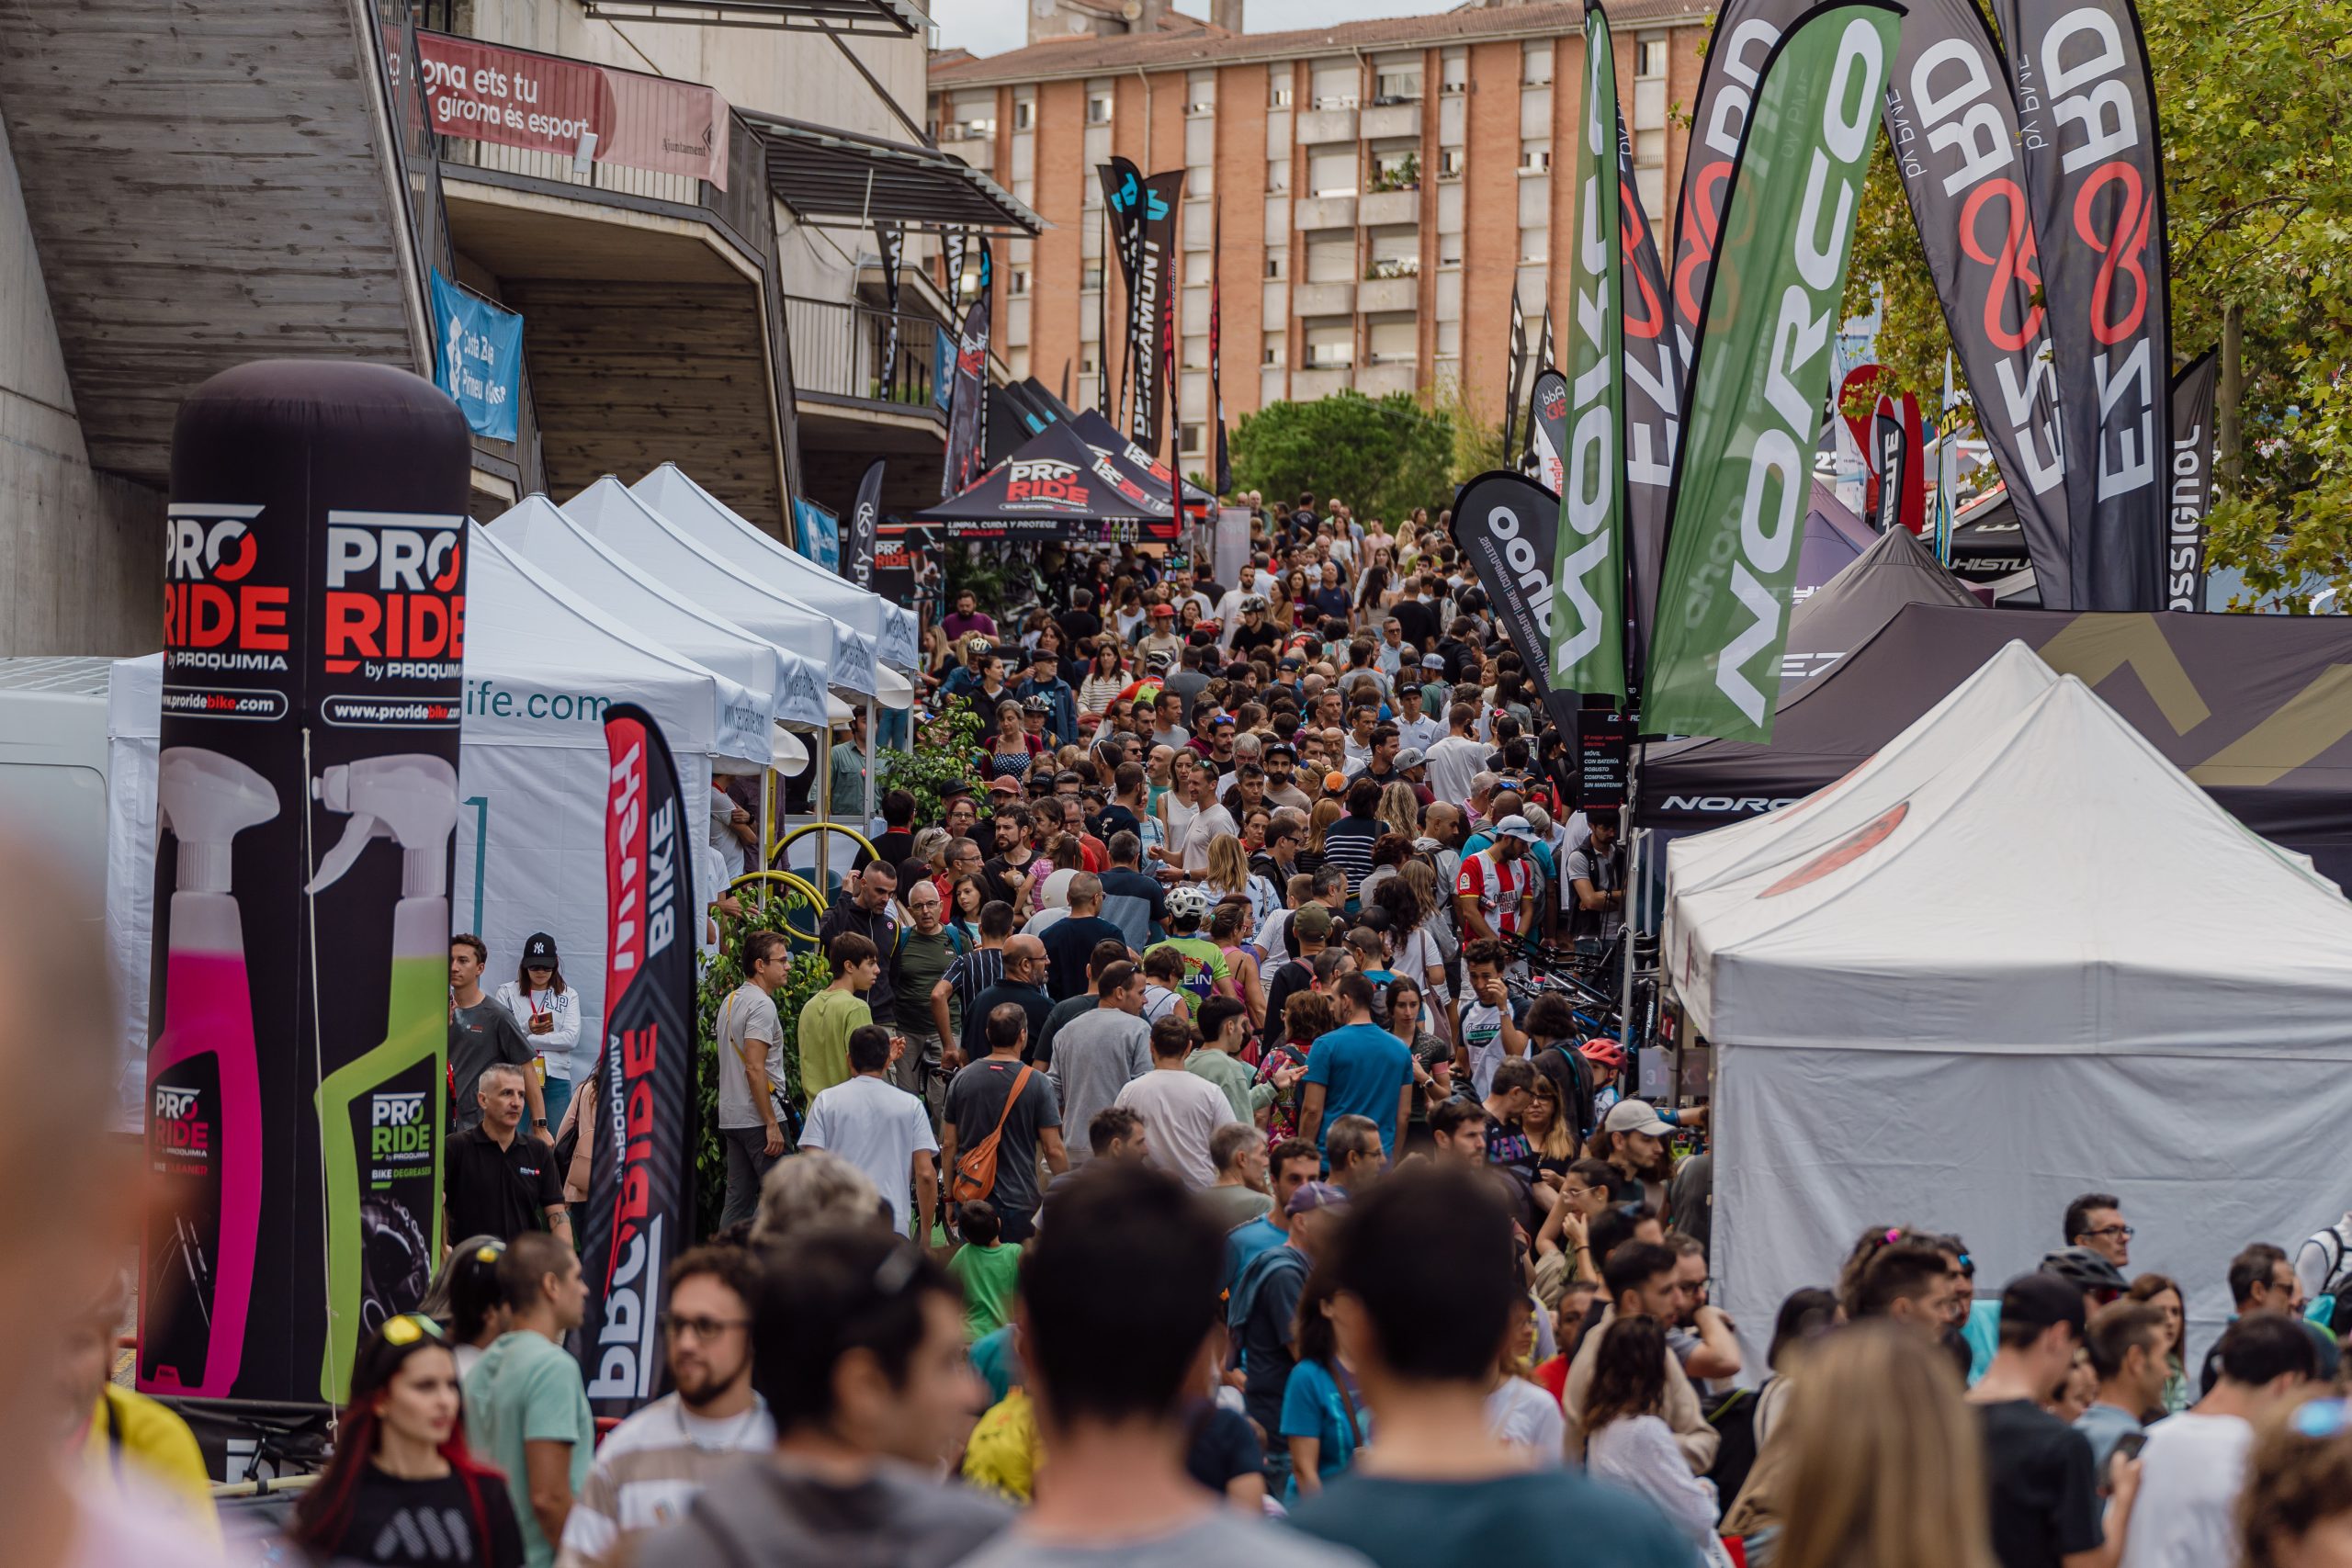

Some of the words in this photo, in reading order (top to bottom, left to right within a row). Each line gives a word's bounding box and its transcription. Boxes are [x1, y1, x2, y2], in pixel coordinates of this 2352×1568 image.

[473, 67, 508, 98] ets
[514, 73, 537, 104] tu
[437, 92, 501, 125] girona
[505, 103, 525, 130] és
[528, 111, 590, 141] esport
[662, 138, 707, 158] Ajuntament
[1714, 18, 1883, 728] NORCO
[1010, 463, 1078, 485] PRO
[1006, 480, 1089, 503] RIDE
[1017, 521, 1057, 529] PROTEGE
[2170, 424, 2200, 612] OSSIGNOL
[165, 519, 257, 581] PRO
[327, 526, 460, 592] PRO
[875, 544, 904, 555] PRO
[875, 555, 910, 570] RIDE
[1949, 558, 2033, 570] HISTL
[164, 583, 289, 650] RIDE
[325, 592, 466, 659] RIDE
[168, 651, 176, 669] by
[176, 652, 288, 671] PROQUIMIA
[365, 660, 384, 682] by
[467, 681, 612, 721] ife.com
[156, 1091, 198, 1120] PRO
[372, 1100, 424, 1126] PRO
[154, 1117, 209, 1149] RIDE
[372, 1124, 431, 1153] RIDE
[393, 1151, 430, 1161] PROQUIMIA
[371, 1168, 392, 1180] BIKE
[393, 1166, 432, 1179] DEGREASER
